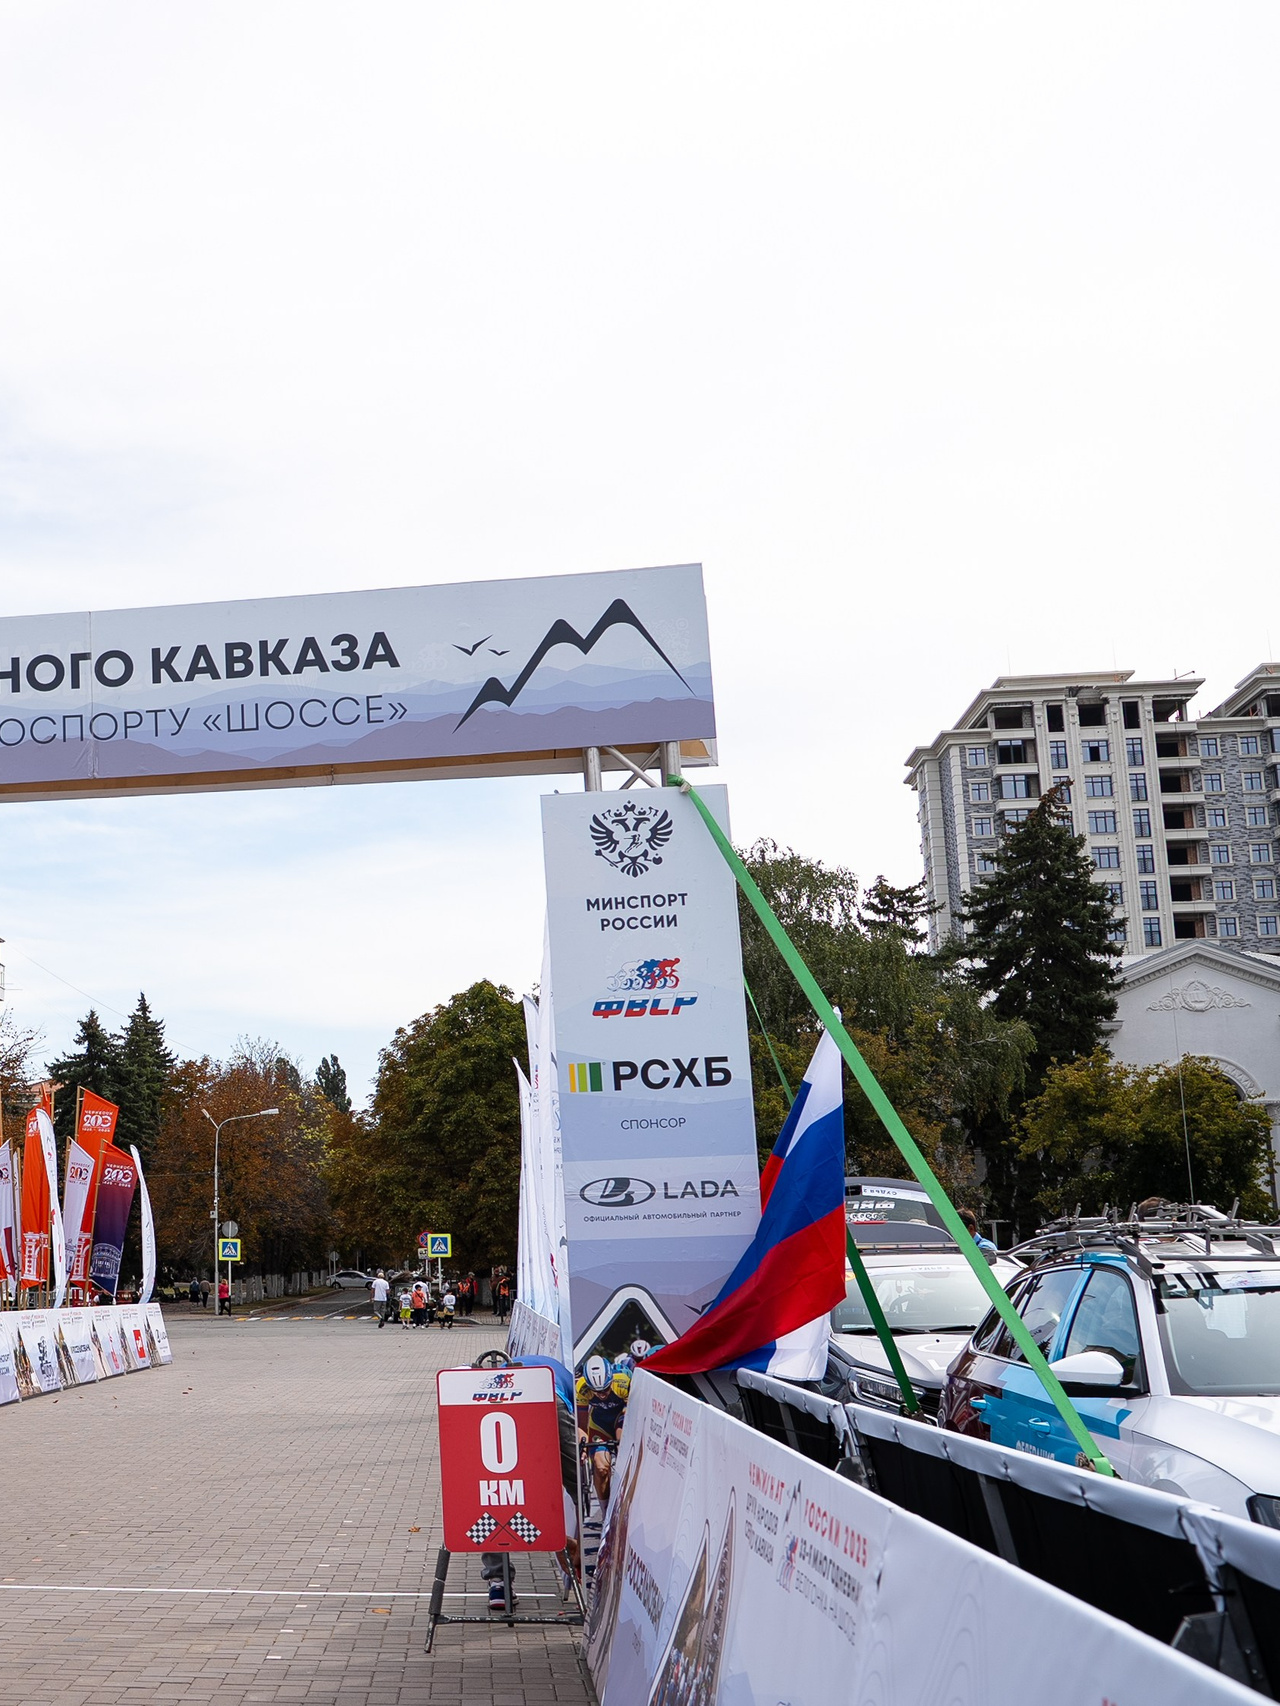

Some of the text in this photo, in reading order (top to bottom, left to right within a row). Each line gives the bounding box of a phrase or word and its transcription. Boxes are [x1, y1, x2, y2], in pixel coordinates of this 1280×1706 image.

[151, 631, 401, 684] КАВКАЗА
[202, 694, 408, 732] «ШОССЕ»
[585, 892, 688, 912] МИНСПОРТ
[600, 914, 678, 932] РОССИИ
[592, 990, 699, 1019] ФВСР
[613, 1055, 732, 1091] РСХБ
[620, 1117, 687, 1131] СПОНСОР
[663, 1179, 740, 1200] LADA
[583, 1210, 742, 1223] ОФИЦИАЛЬНЫЙ АВТОМОБИЛЬНЫЙ ПАРТНЕР
[480, 1411, 518, 1474] 0
[479, 1479, 525, 1506] КМ
[843, 1525, 869, 1568] 2025
